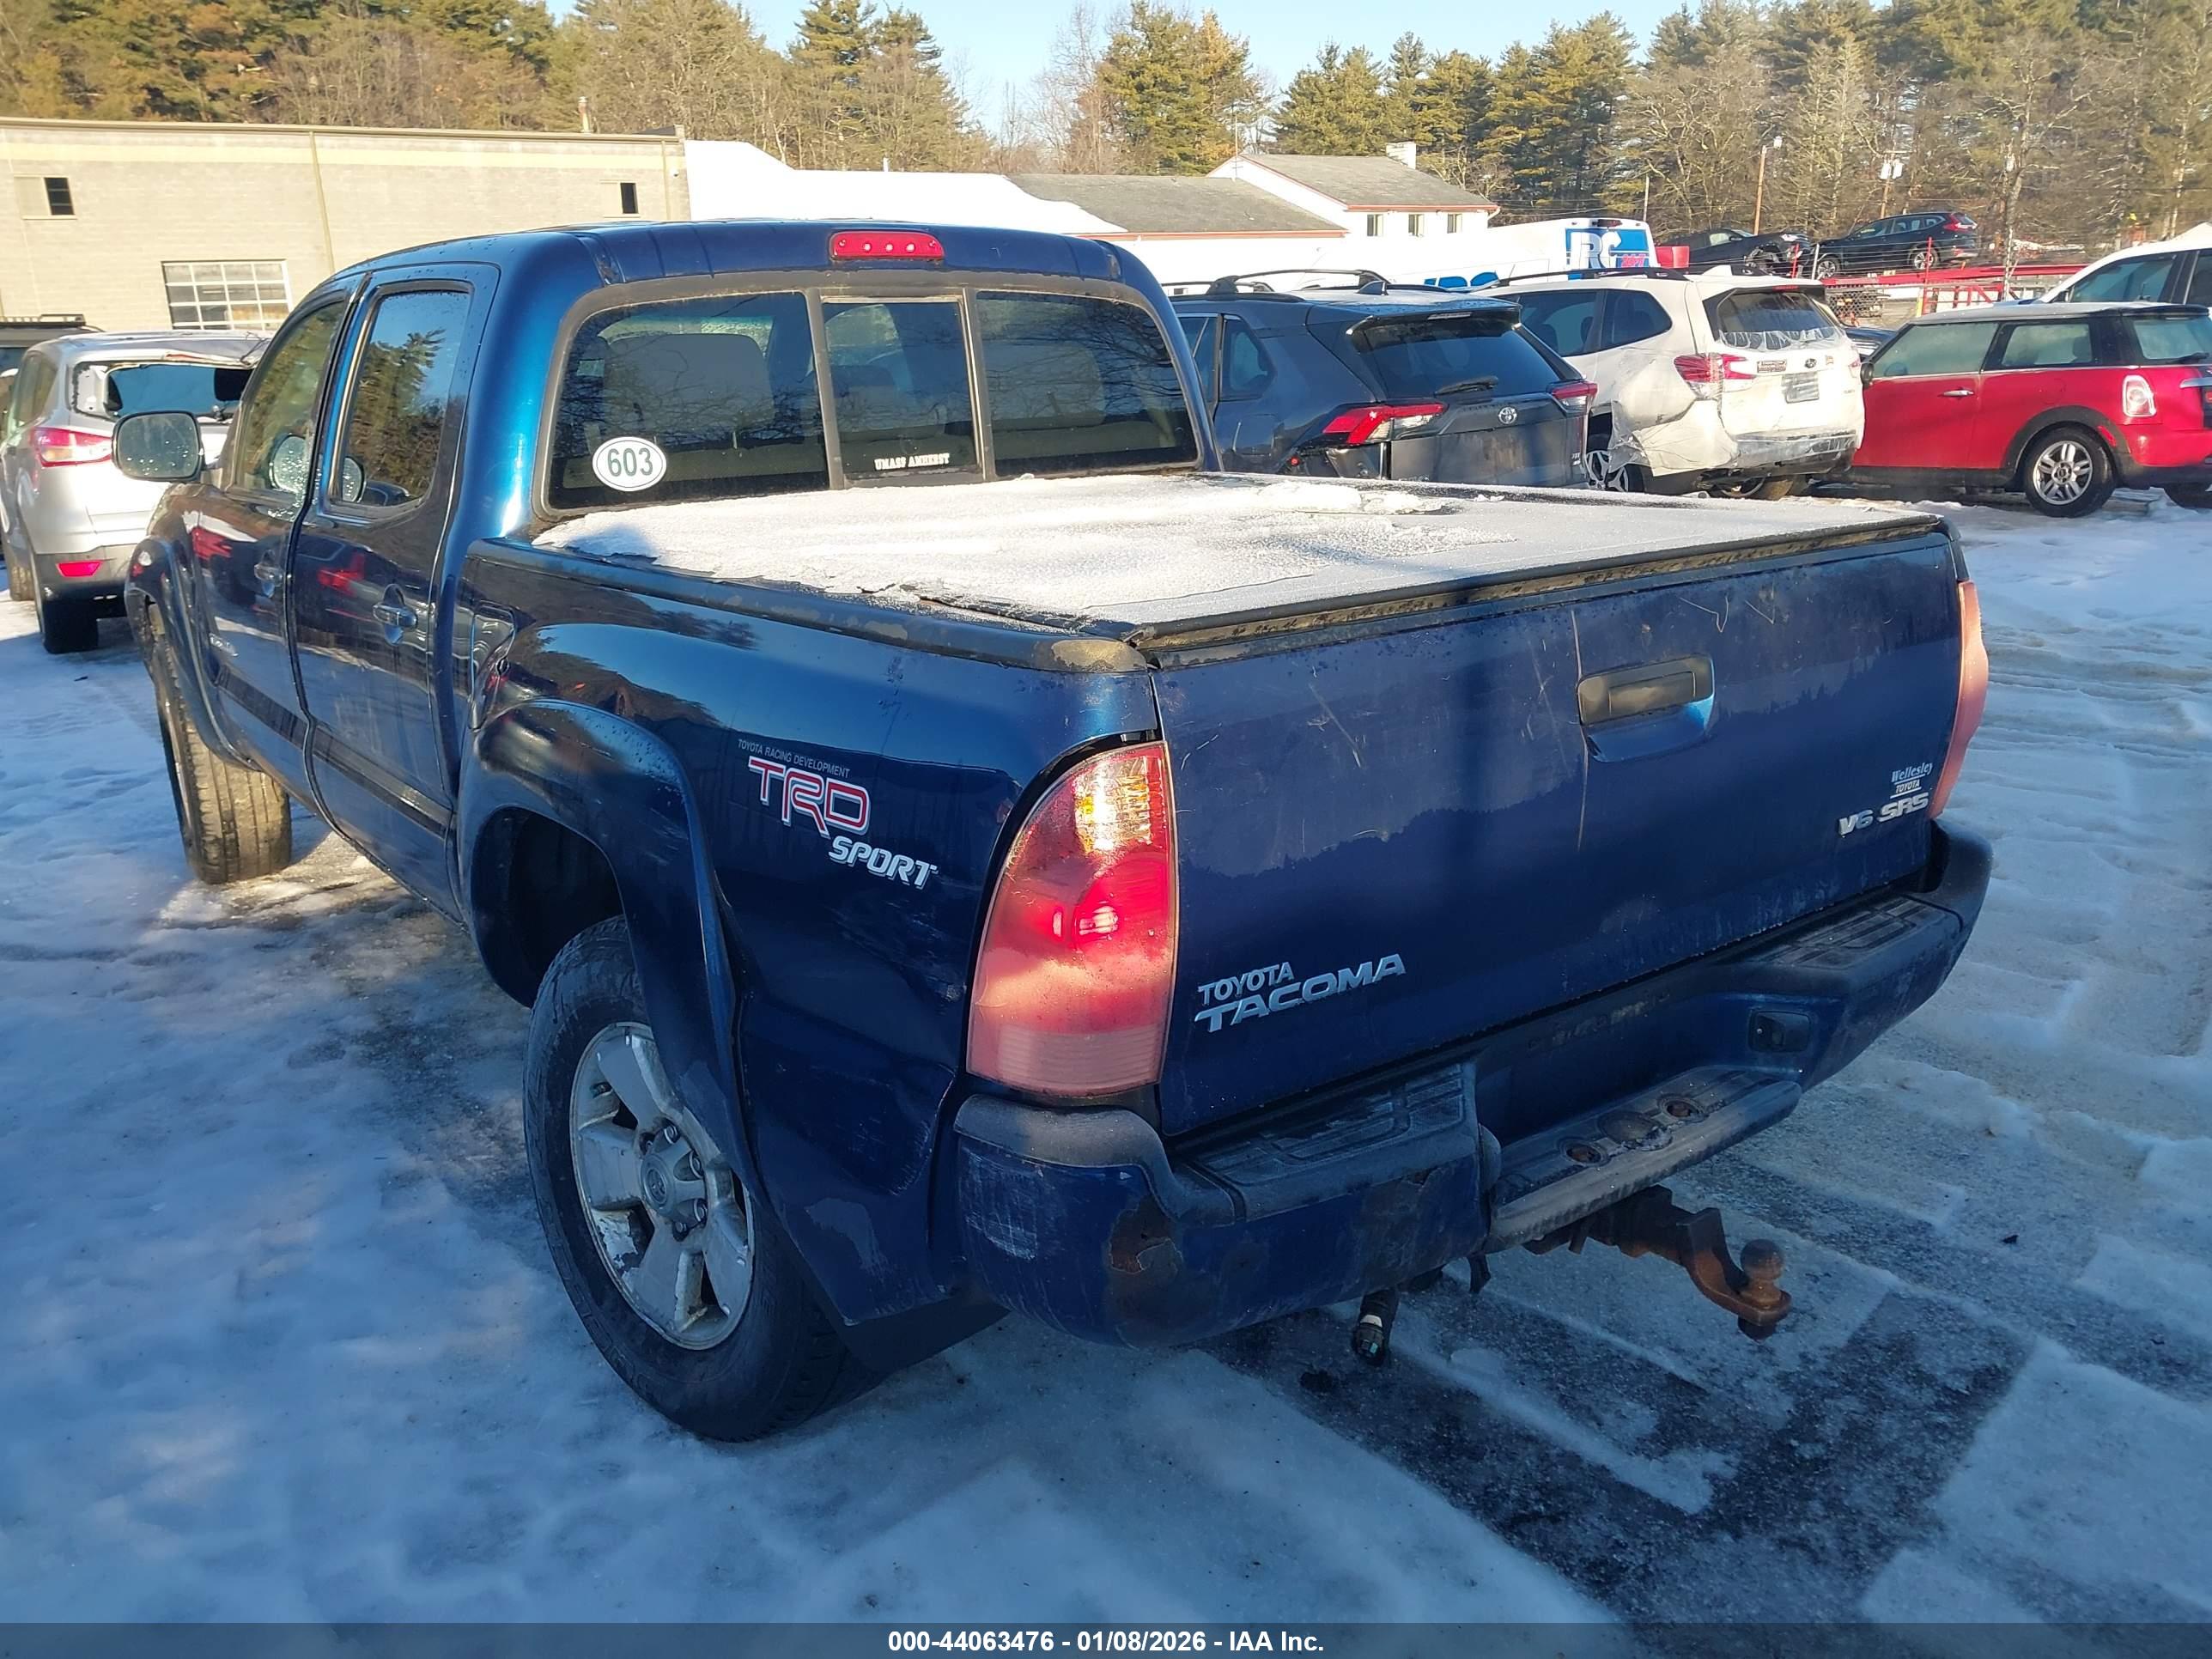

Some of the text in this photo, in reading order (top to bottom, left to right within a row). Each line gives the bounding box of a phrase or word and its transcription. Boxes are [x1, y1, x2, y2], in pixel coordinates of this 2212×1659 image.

[607, 447, 653, 477] 603
[874, 457, 907, 471] UMASS
[738, 738, 850, 779] TOYOTA RACING DEVELOPMENT
[1891, 763, 1933, 782] Wellesley
[748, 756, 871, 840] TRD
[1895, 779, 1920, 794] TOYOTA
[1838, 792, 1929, 836] V6 SR5
[829, 836, 939, 889] SPORT
[1194, 953, 1407, 1032] TACOMA
[1197, 961, 1294, 1006] TOYOTA
